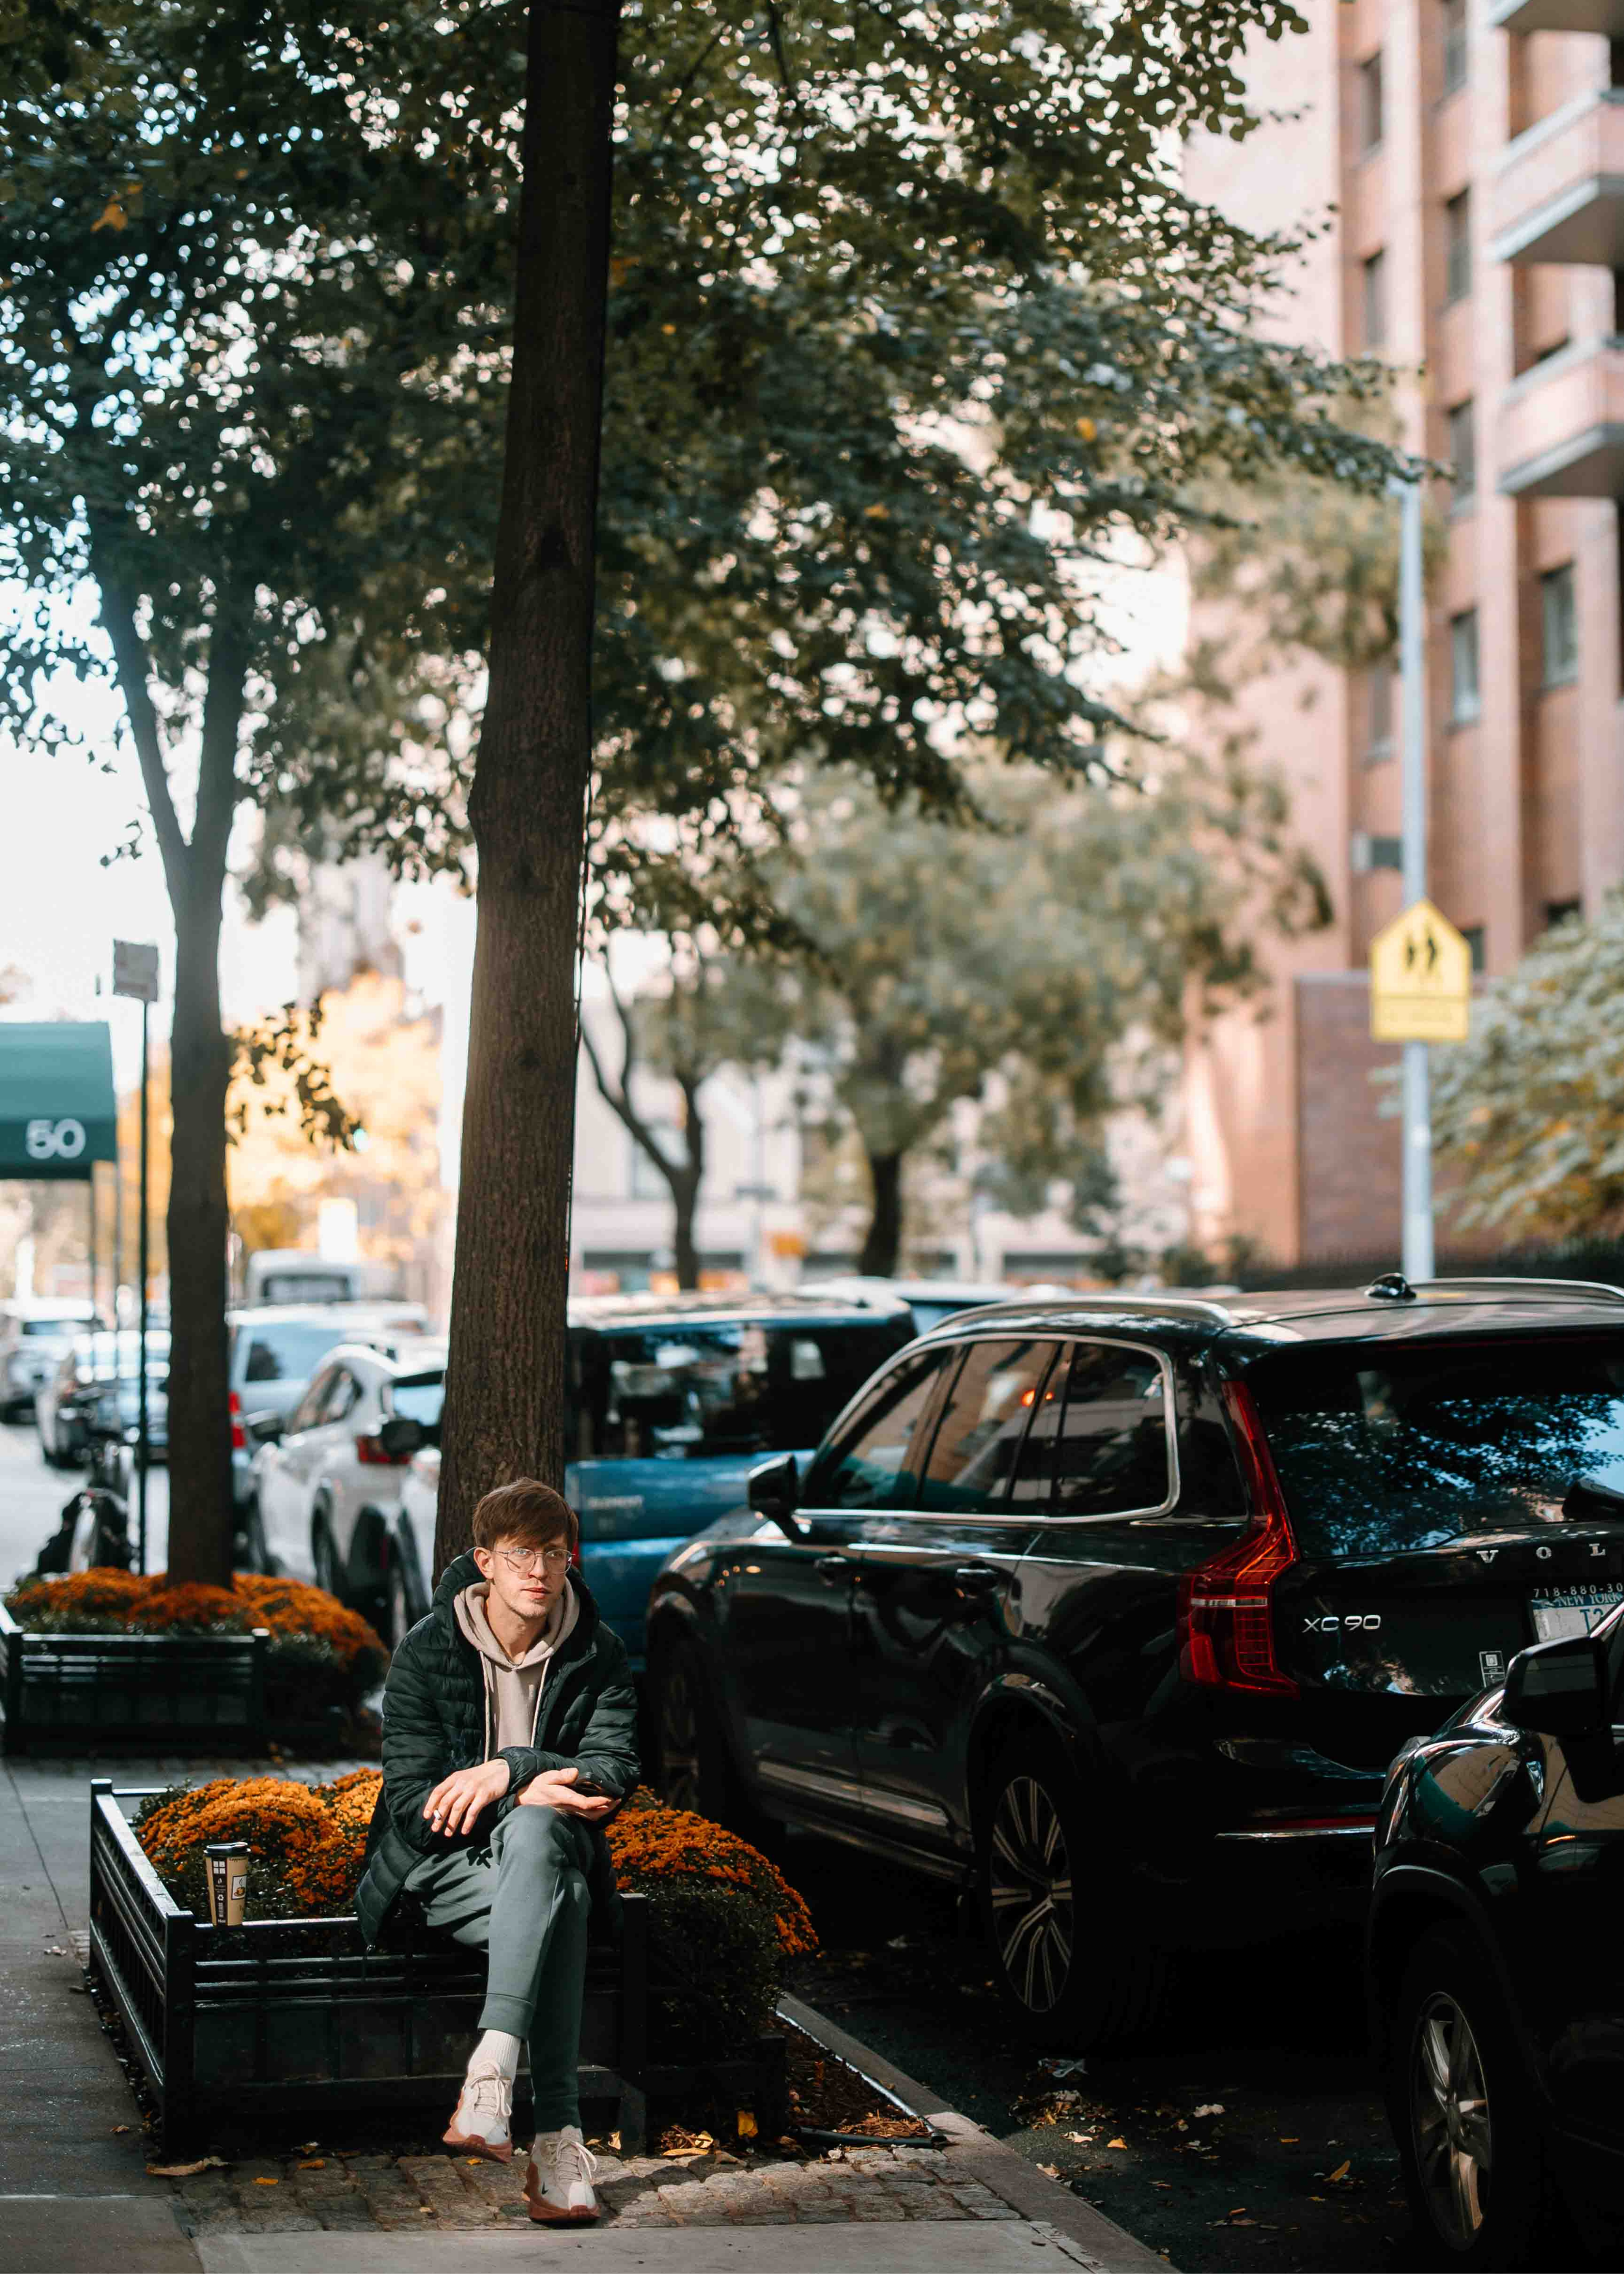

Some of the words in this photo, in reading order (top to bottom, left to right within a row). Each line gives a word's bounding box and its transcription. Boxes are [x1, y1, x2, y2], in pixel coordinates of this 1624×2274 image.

[26, 1118, 86, 1159] 50
[1557, 1596, 1584, 1606] NEW
[1590, 1592, 1621, 1603] YORK
